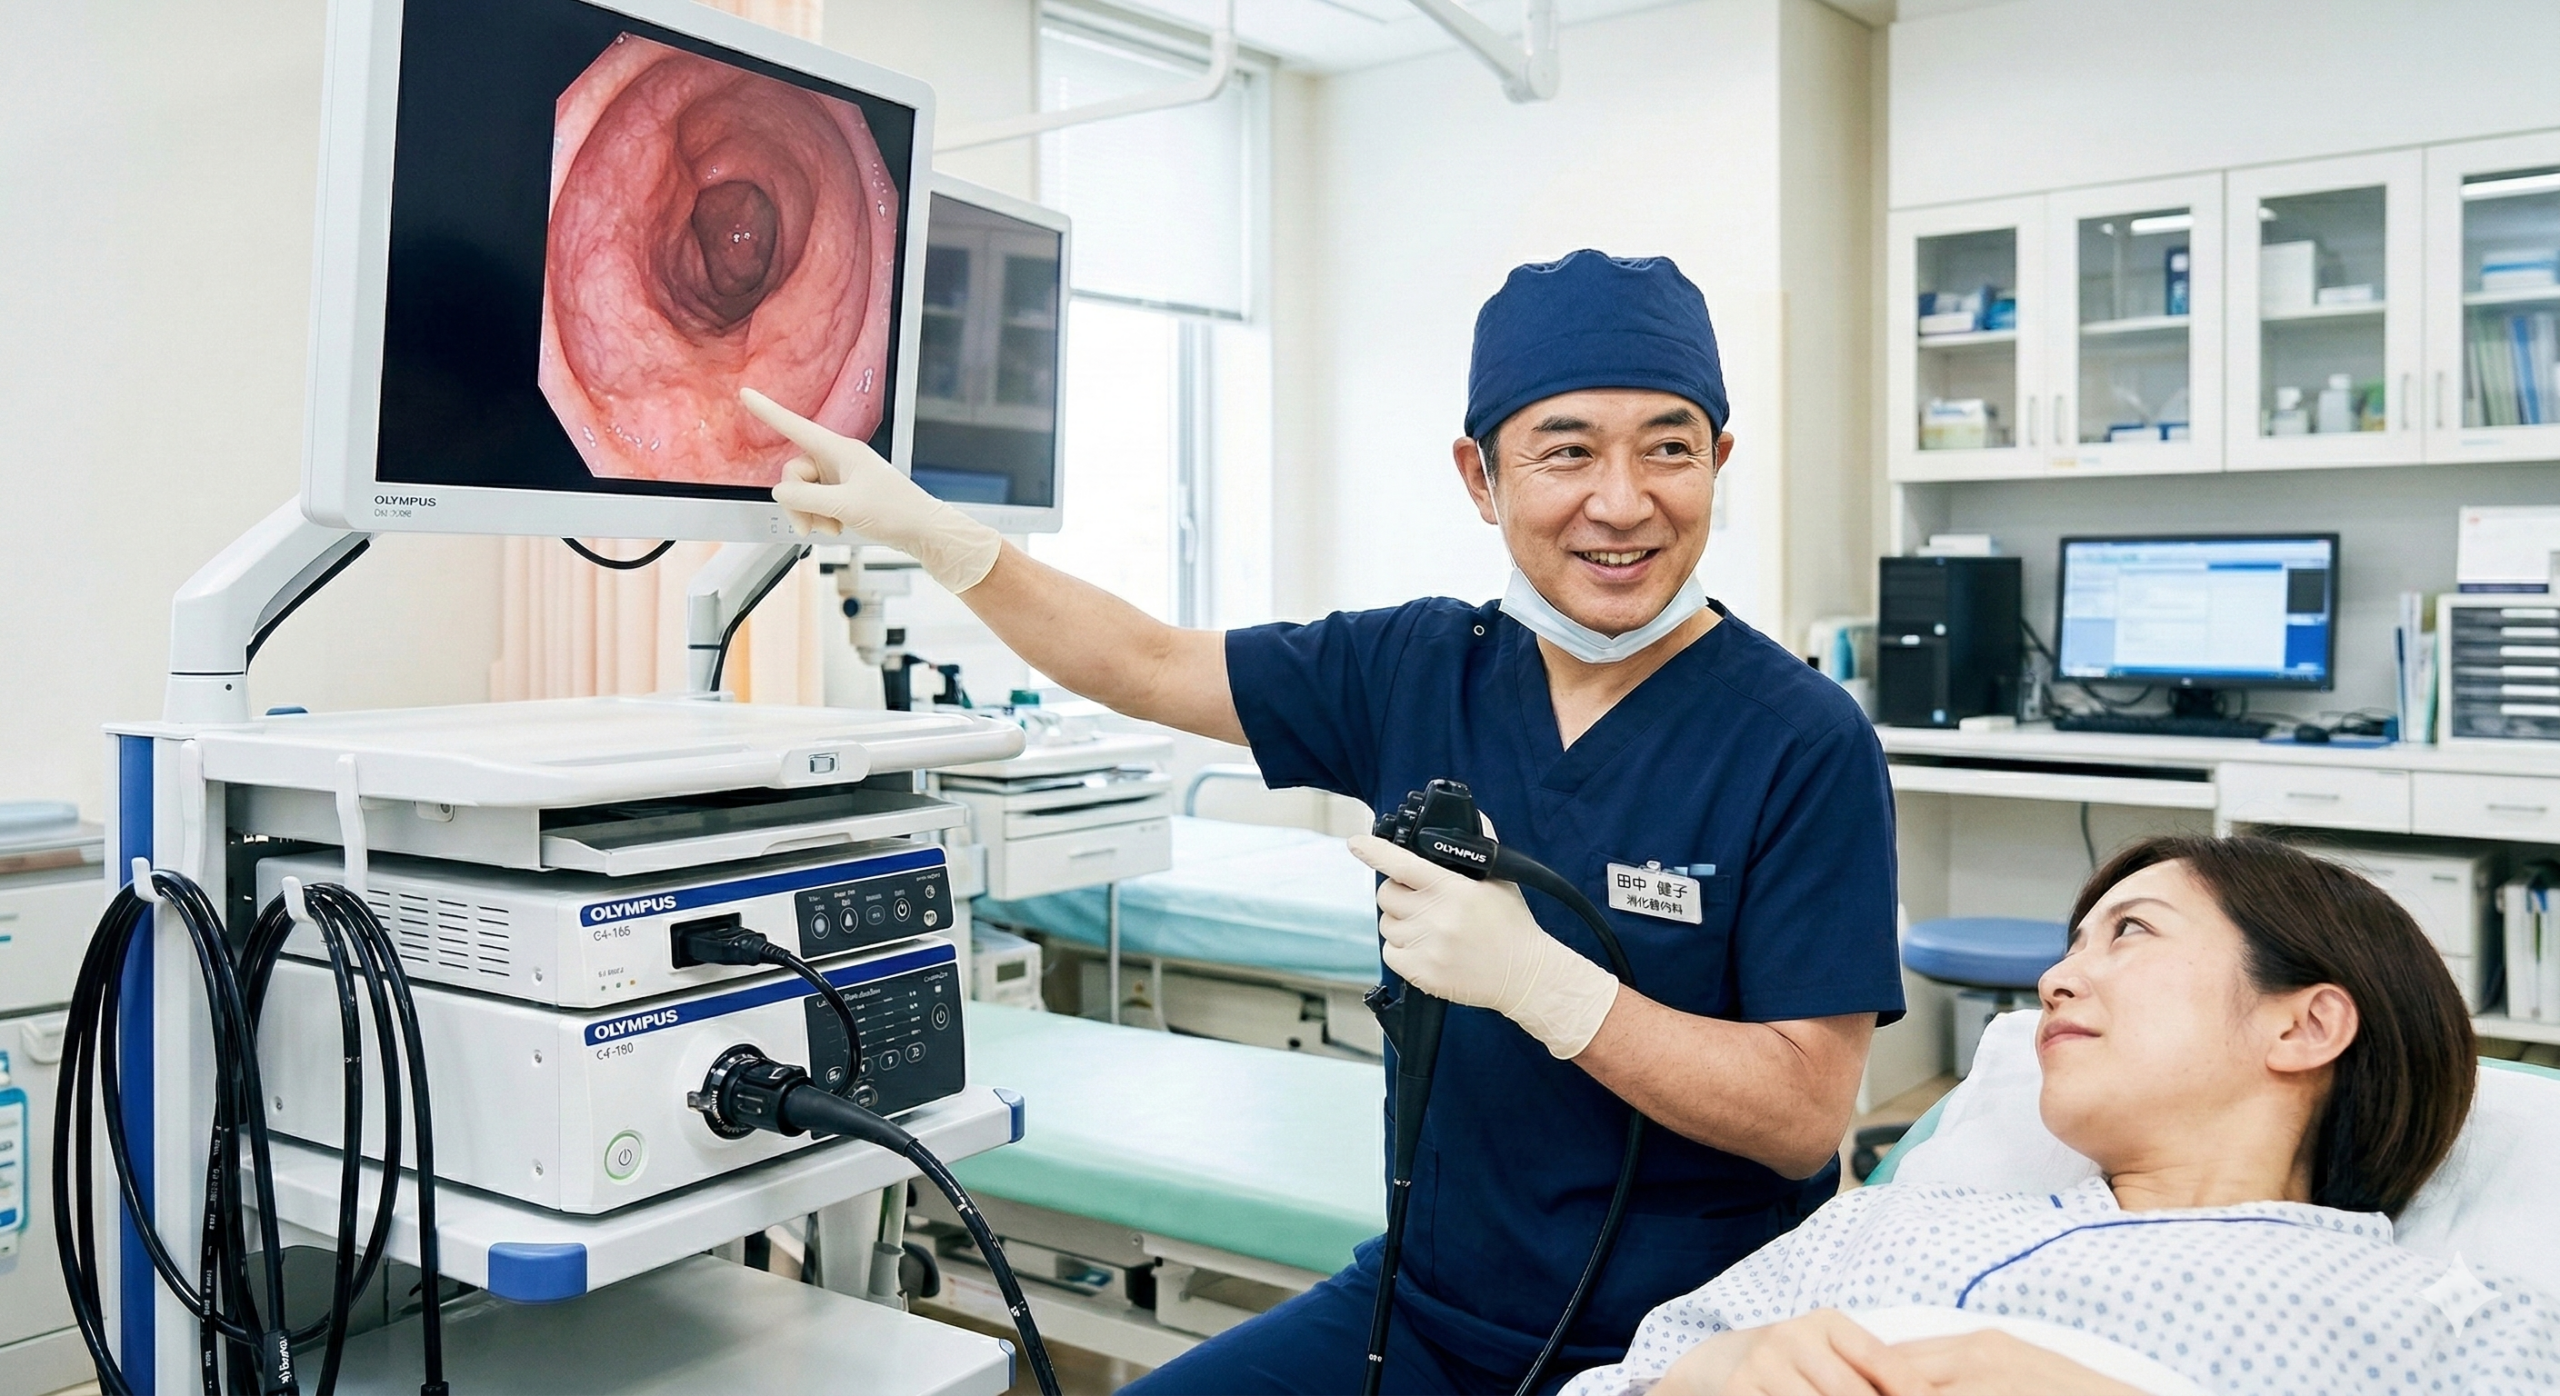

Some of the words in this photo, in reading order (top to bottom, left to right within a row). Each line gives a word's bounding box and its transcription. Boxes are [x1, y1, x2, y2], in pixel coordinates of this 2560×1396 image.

[374, 495, 437, 507] OLYMPUS
[1617, 873, 1647, 891] 田中
[590, 895, 677, 922] OLYMPUS
[594, 1009, 679, 1040] OLYMPUS
